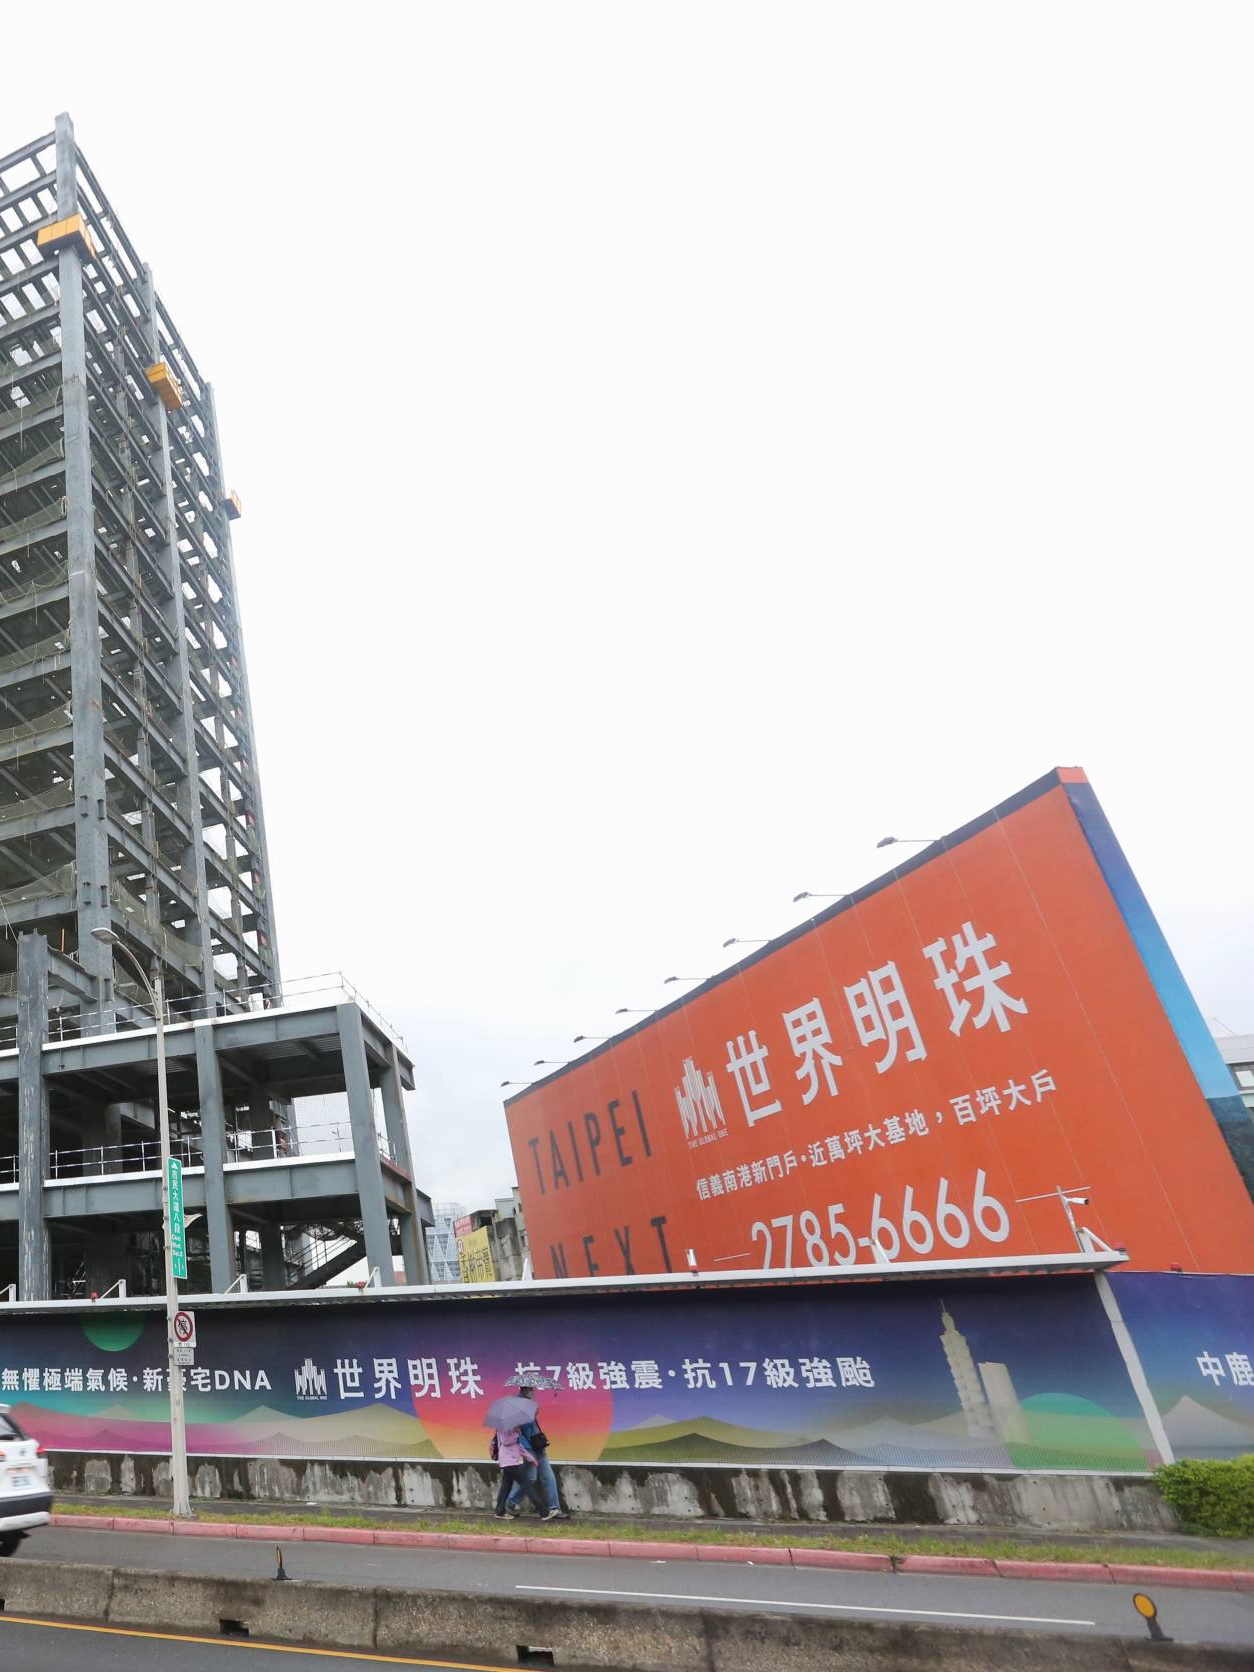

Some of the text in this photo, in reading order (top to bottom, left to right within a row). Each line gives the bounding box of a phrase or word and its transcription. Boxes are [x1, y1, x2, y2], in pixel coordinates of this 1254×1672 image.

[726, 921, 1029, 1127] 世界明珠
[528, 1089, 651, 1195] TAIPEI
[688, 1139, 699, 1150] THE
[699, 1133, 718, 1146] GLOBAL
[550, 1216, 672, 1278] NEXT
[751, 1168, 1011, 1270] 2785-6666
[334, 1356, 484, 1400] 世界明珠
